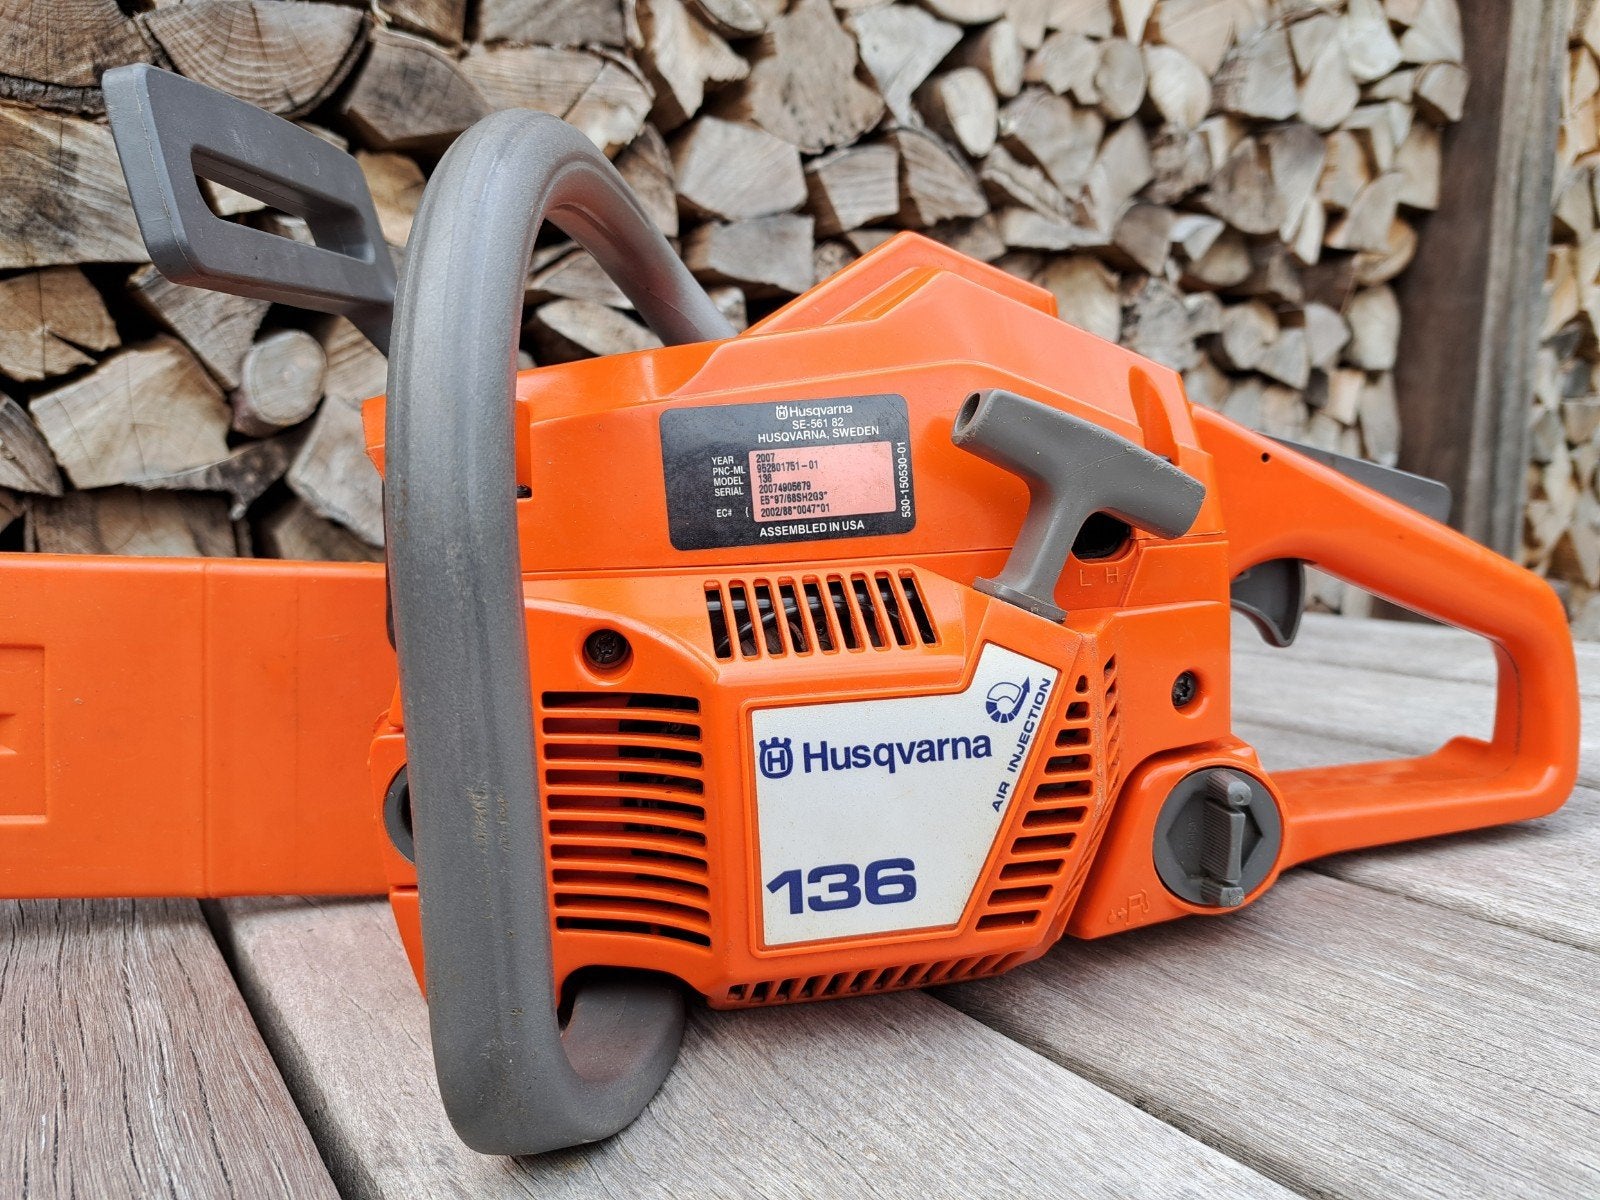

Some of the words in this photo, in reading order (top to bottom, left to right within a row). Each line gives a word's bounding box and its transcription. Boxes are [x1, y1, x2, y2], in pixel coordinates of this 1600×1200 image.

[789, 404, 853, 418] Husqvarna
[792, 419, 828, 430] SE-561
[831, 417, 845, 428] 82
[758, 430, 830, 444] HUSQVARNA,
[832, 426, 880, 439] SWEDEN
[711, 456, 735, 465] YEAR
[756, 452, 775, 464] 2007
[712, 465, 747, 476] PNC-ML
[713, 476, 744, 486] MODEL
[896, 442, 912, 518] 530-150530-01
[714, 487, 744, 497] SERIAL
[759, 523, 827, 538] ASSEMBLED
[829, 522, 843, 533] IN
[844, 520, 865, 531] USA
[1079, 568, 1093, 587] L
[1105, 566, 1120, 584] H
[991, 780, 1011, 813] AIR
[1006, 677, 1052, 774] INJECTION
[802, 734, 993, 774] Husqvarna
[765, 857, 918, 915] 136
